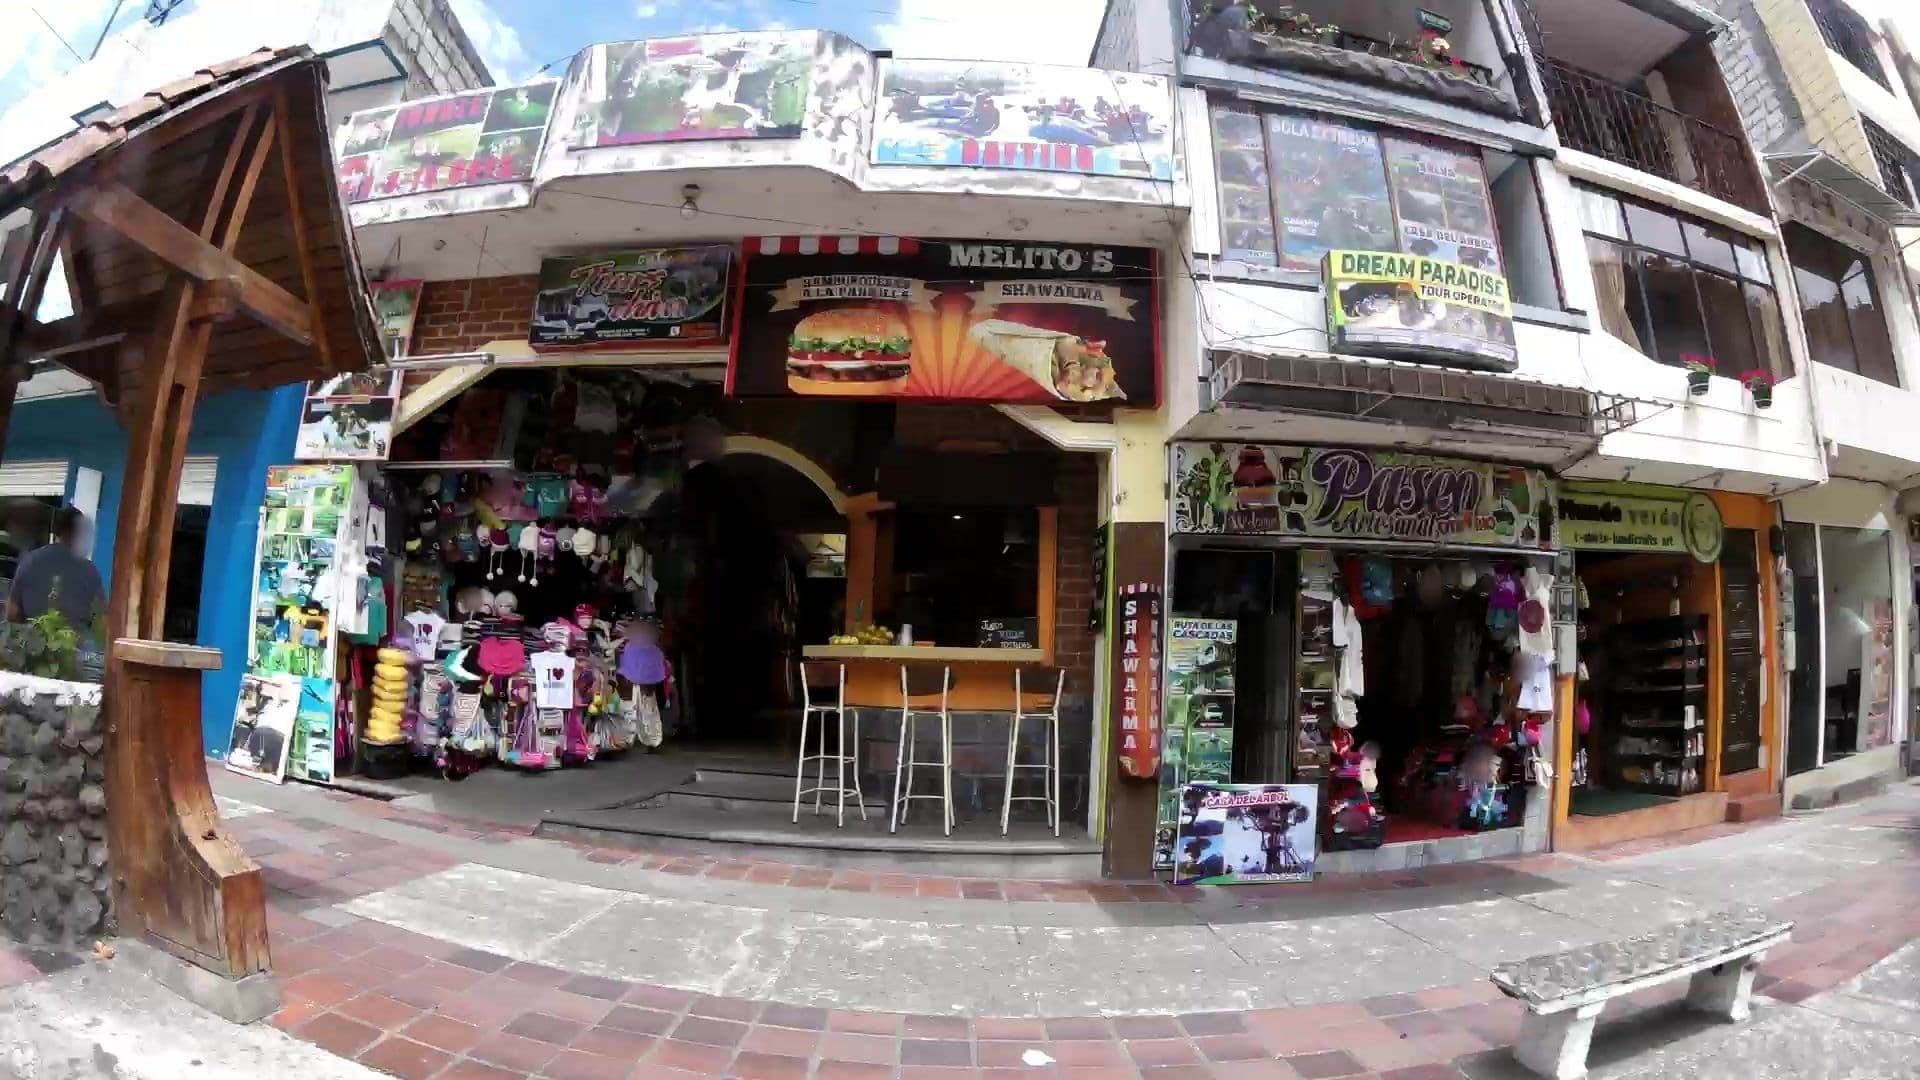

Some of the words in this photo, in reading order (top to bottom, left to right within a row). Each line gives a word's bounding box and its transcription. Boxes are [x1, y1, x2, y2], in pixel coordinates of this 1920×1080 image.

[1341, 253, 1415, 279] DREAM
[1420, 260, 1504, 297] PARADISE
[1001, 282, 1104, 301] SHAWARMA
[1420, 285, 1450, 300] TOUR
[1172, 629, 1234, 641] CASCADAS
